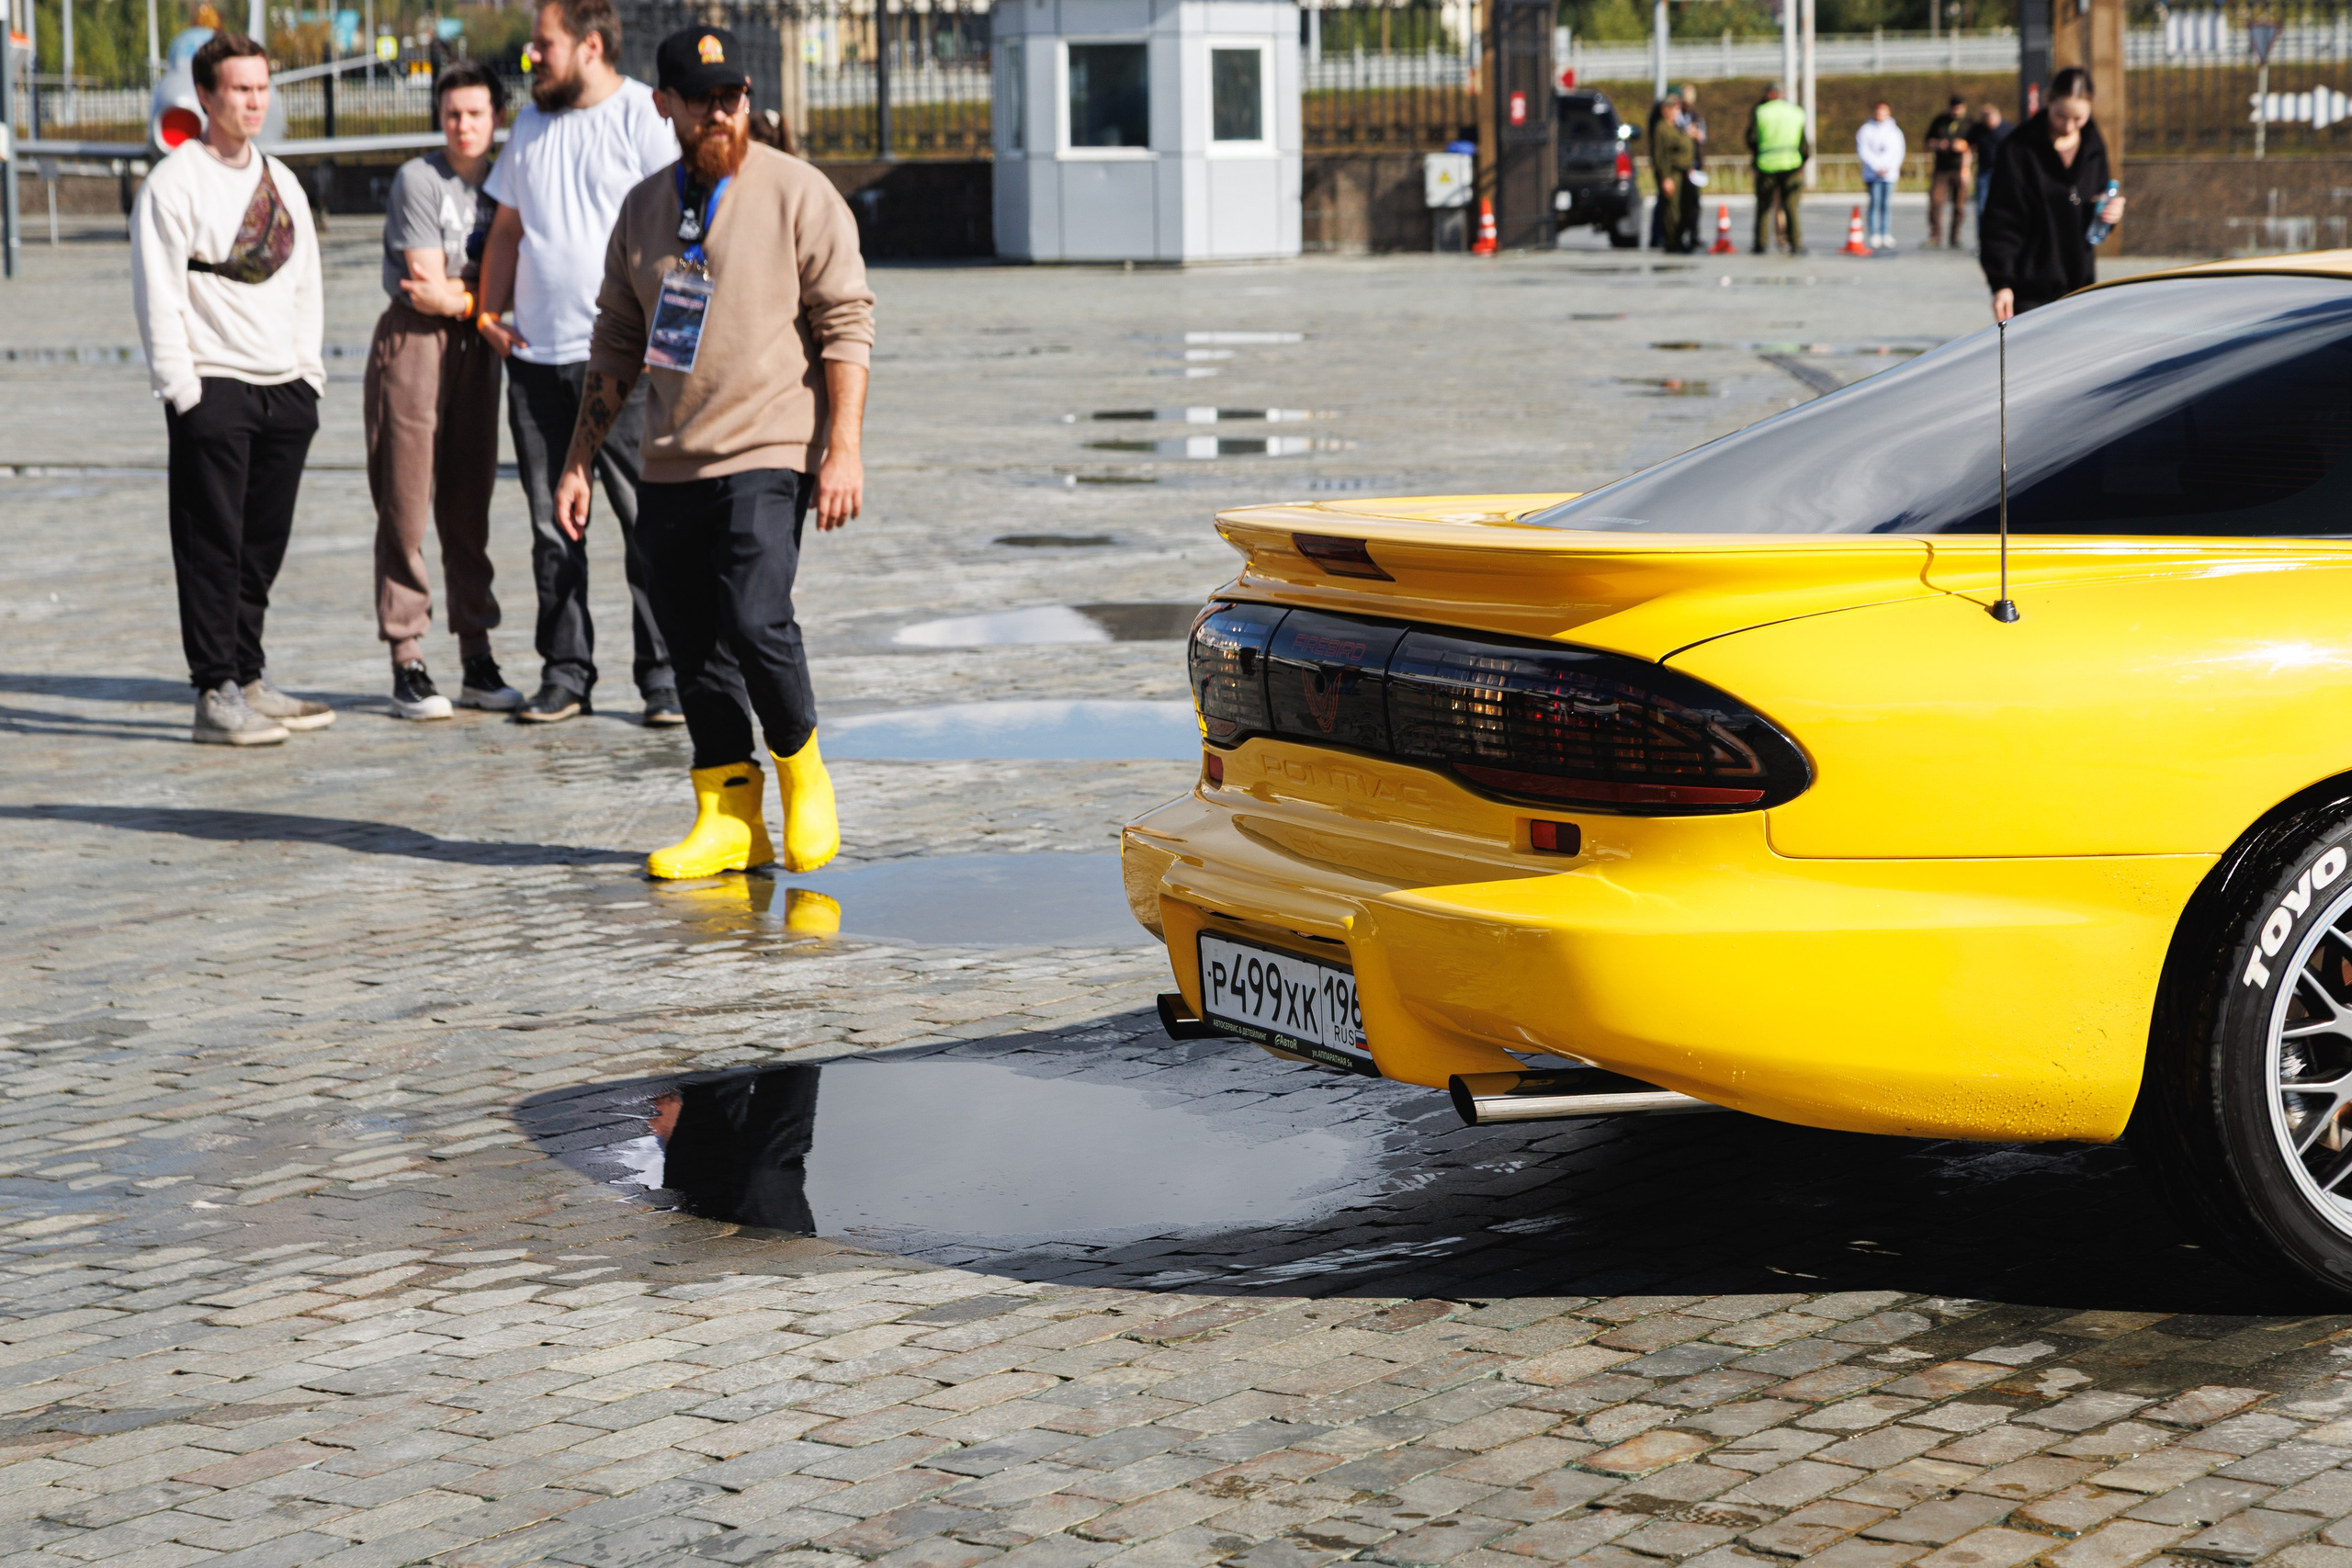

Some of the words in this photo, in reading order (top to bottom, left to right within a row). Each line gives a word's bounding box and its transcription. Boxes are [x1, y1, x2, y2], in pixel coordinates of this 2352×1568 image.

[1291, 633, 1366, 661] FIREBIRD
[1260, 753, 1431, 810] PONTIAC
[2243, 846, 2347, 989] TOYO
[1324, 976, 1363, 1029] 196
[1334, 1024, 1355, 1046] RUS
